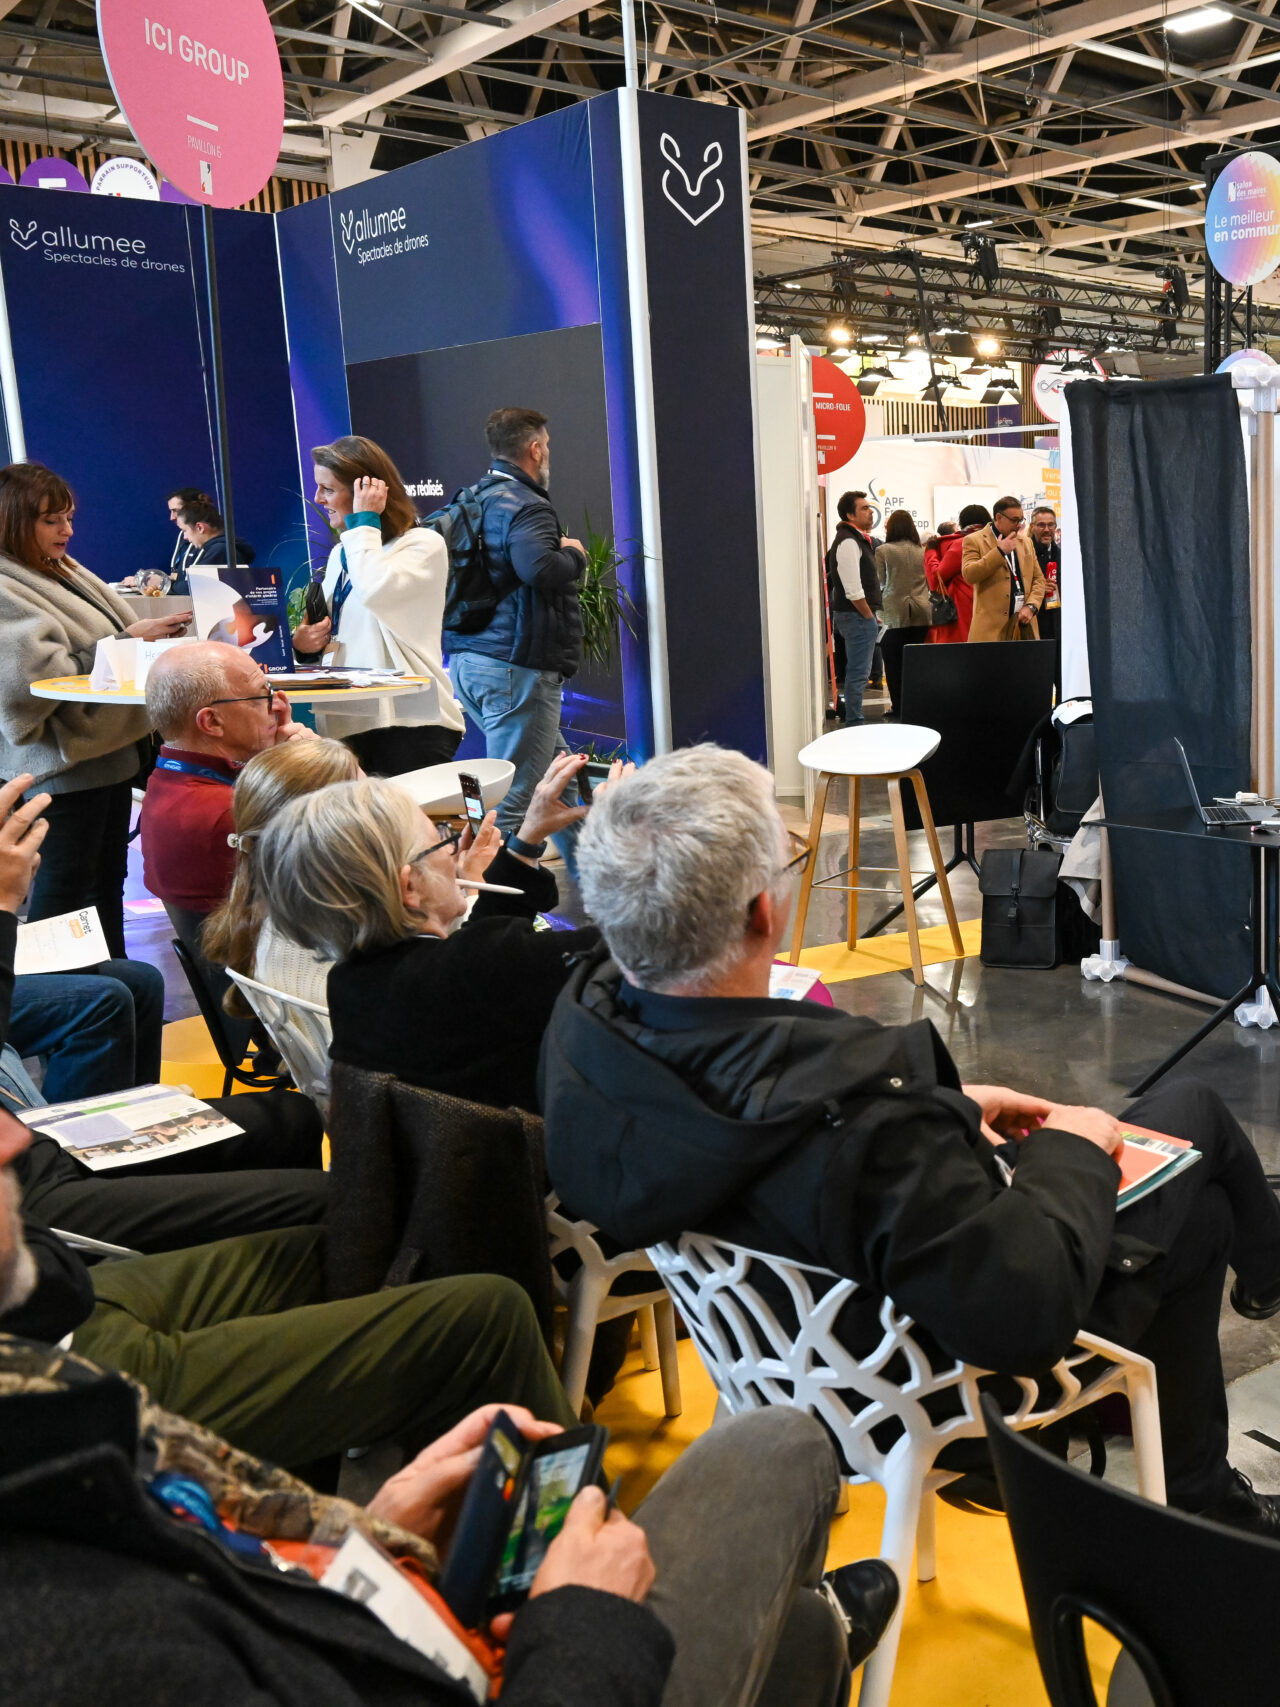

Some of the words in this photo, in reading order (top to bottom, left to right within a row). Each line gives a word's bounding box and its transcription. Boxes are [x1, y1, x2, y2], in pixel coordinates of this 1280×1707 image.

[144, 18, 172, 55] ICI
[178, 34, 250, 86] GROUP
[187, 135, 216, 156] PAVILLON
[96, 165, 116, 191] PARRAIN
[116, 164, 154, 191] SUPPORTEUR
[1214, 215, 1228, 229] Le
[1230, 209, 1275, 226] meilleur
[1214, 230, 1229, 242] en
[358, 242, 393, 266] Spectacles
[394, 238, 403, 254] de
[404, 234, 429, 251] drones
[44, 249, 118, 267] Spectacles
[121, 256, 138, 269] de
[141, 258, 186, 273] drones
[815, 402, 851, 411] MICRO-FOLIE
[417, 480, 444, 497] réalisés
[884, 497, 904, 506] APF
[79, 910, 92, 935] Carnet
